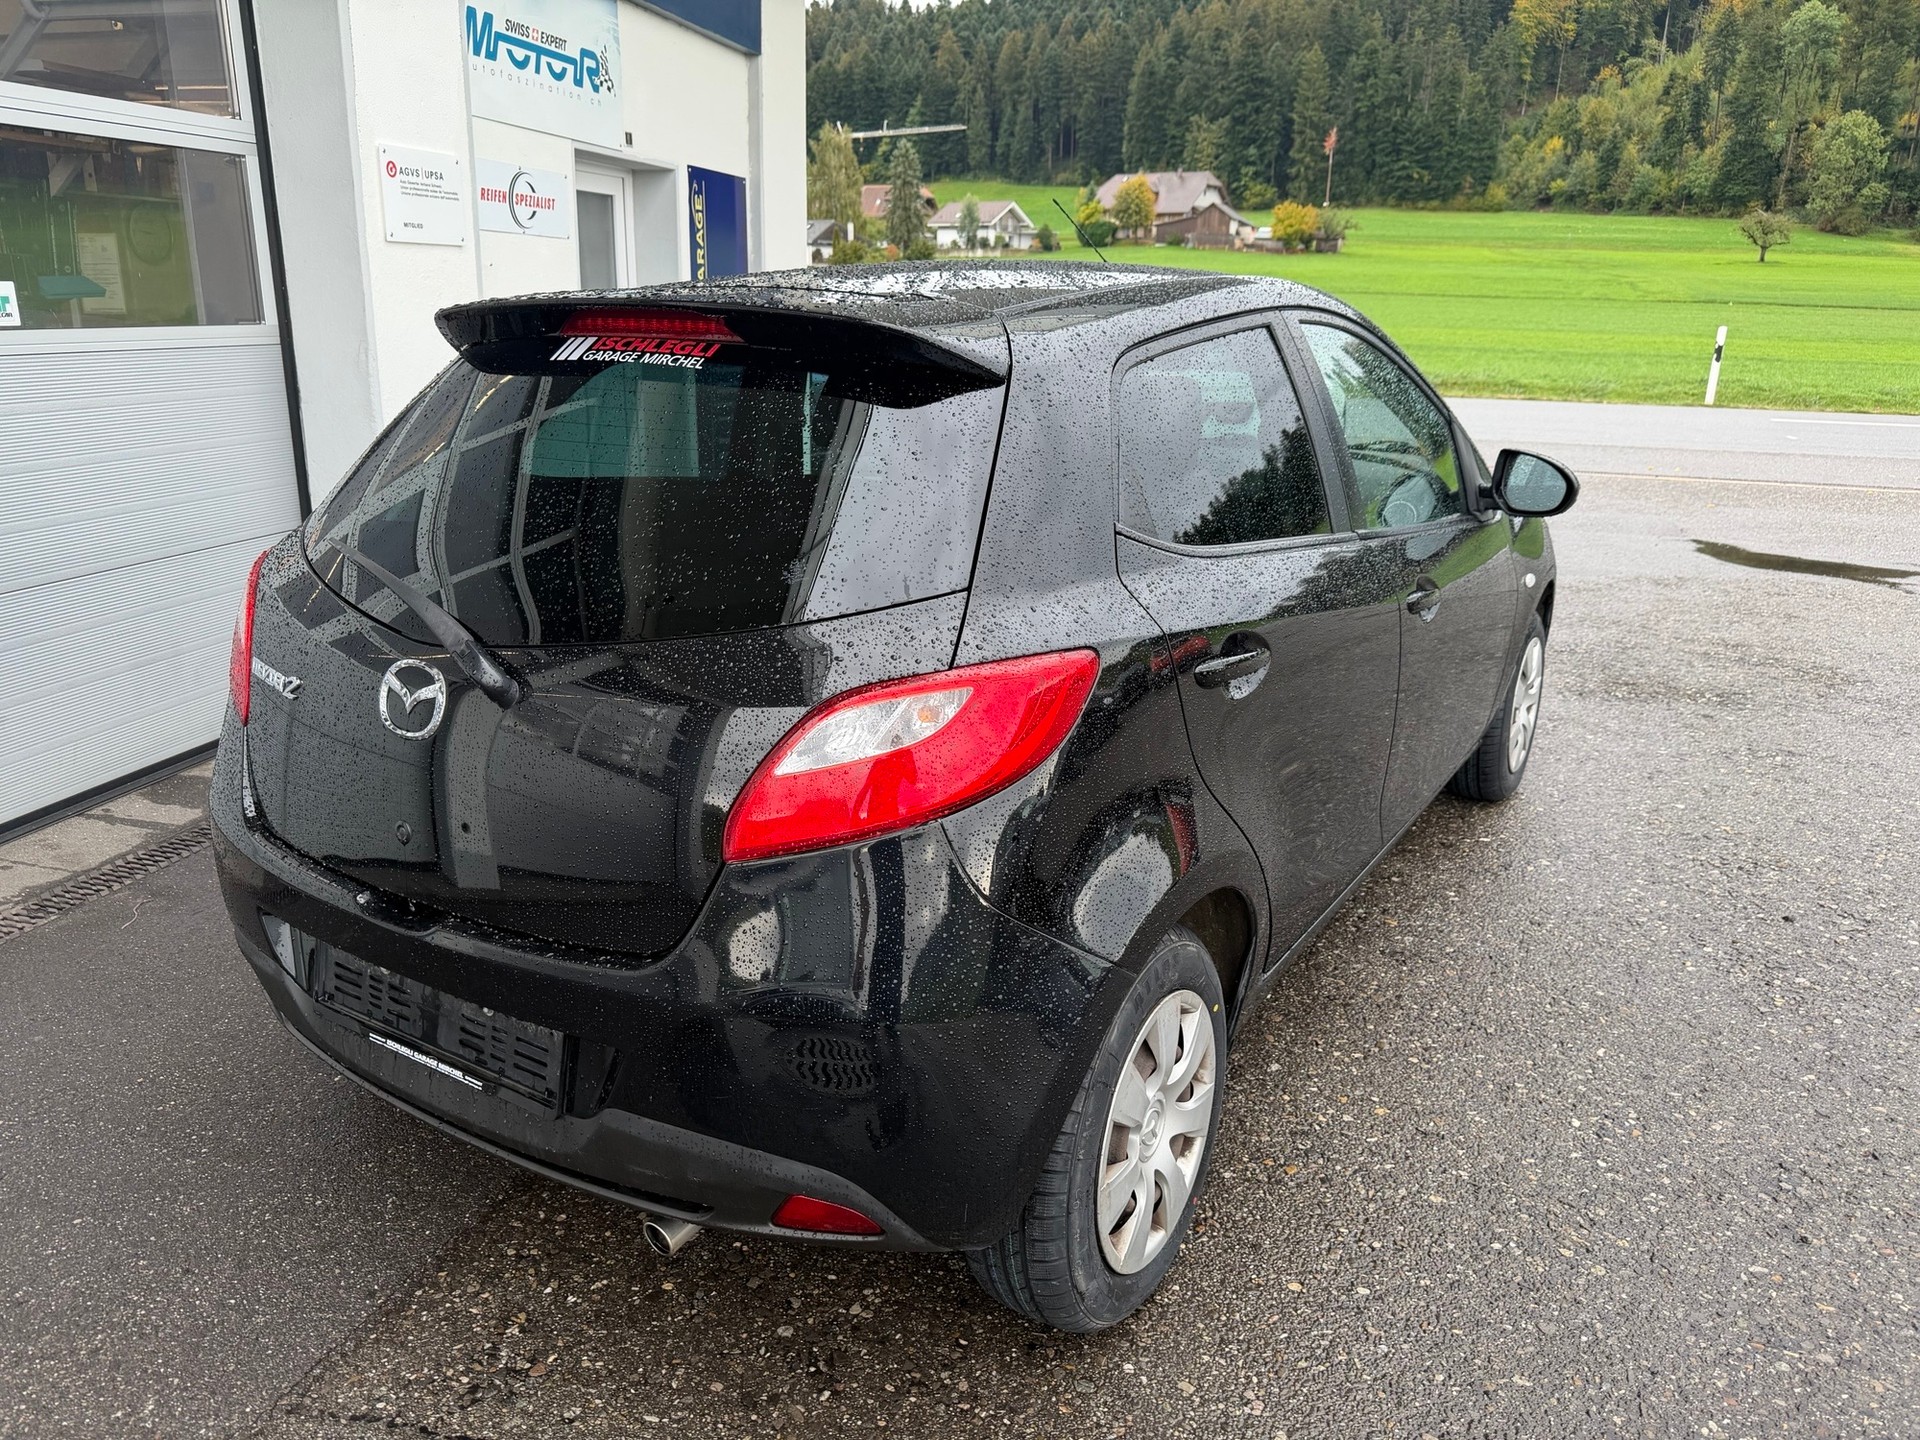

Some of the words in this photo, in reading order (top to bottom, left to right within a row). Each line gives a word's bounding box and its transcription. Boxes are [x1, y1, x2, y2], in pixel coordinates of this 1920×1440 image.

[504, 19, 531, 38] SWISS
[540, 32, 568, 51] EXPERT
[472, 64, 602, 106] utofaszination.ch
[399, 166, 420, 178] AGVS
[425, 170, 444, 181] UPSA
[480, 188, 507, 205] REIFEN
[515, 194, 556, 211] SPEZIALIST
[694, 194, 705, 282] ARAGE
[592, 337, 721, 357] ISCHLEGLI
[582, 351, 642, 363] GARAGE
[639, 353, 705, 370] MIRCHEL
